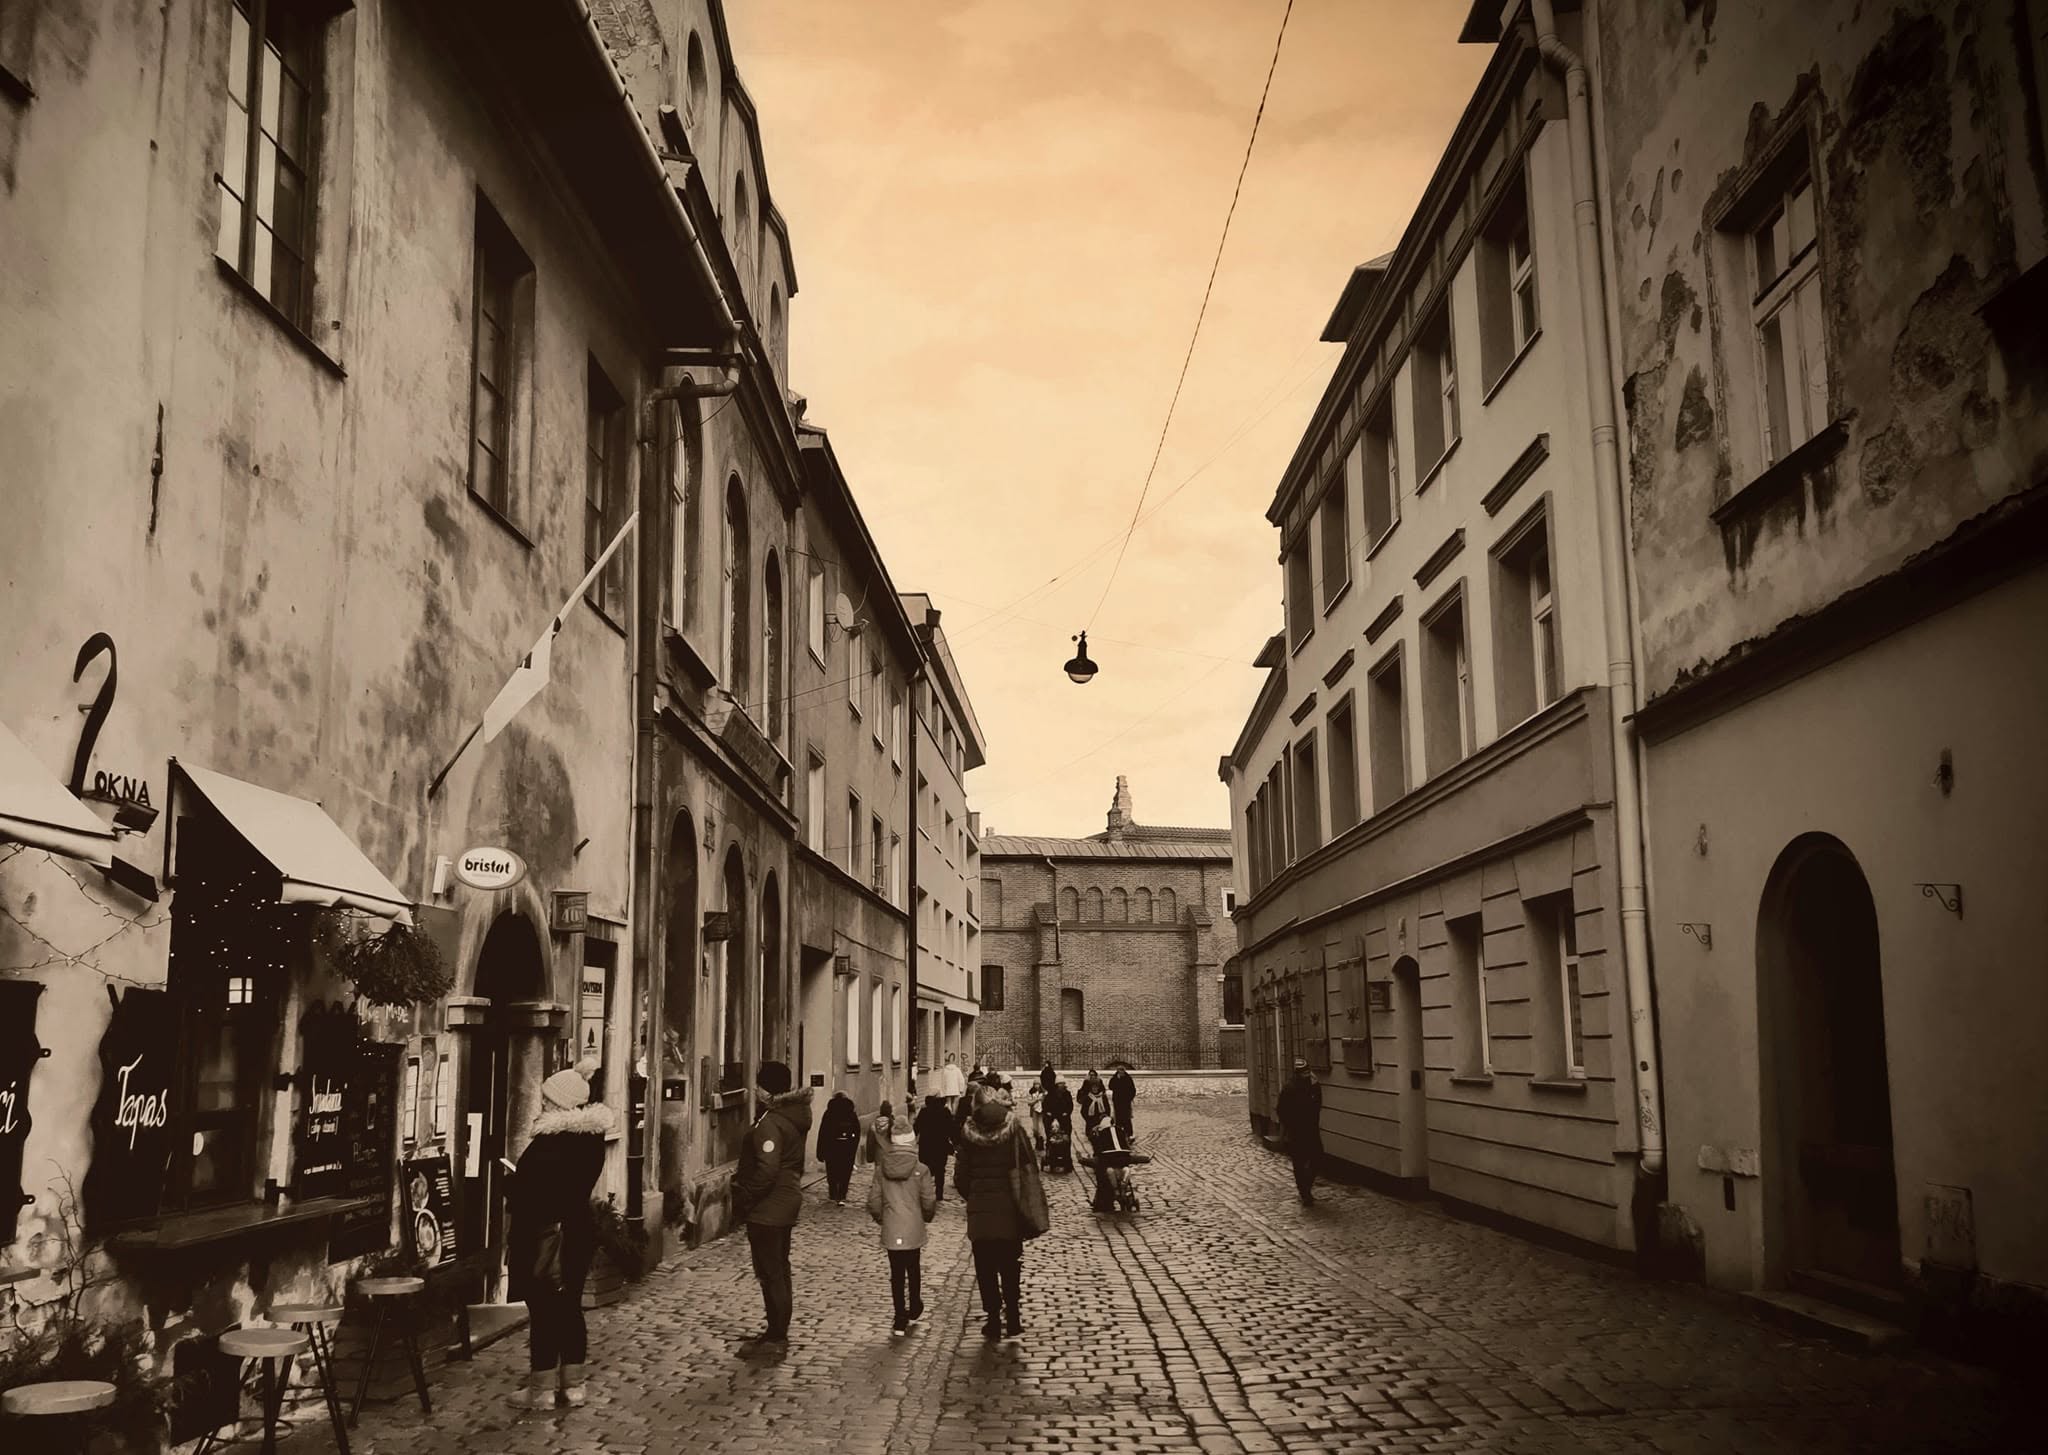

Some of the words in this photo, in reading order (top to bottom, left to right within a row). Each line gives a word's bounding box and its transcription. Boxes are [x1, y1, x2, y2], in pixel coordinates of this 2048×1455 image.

[94, 771, 151, 806] OKNA
[464, 857, 511, 875] bristot
[115, 1053, 168, 1150] Tapas
